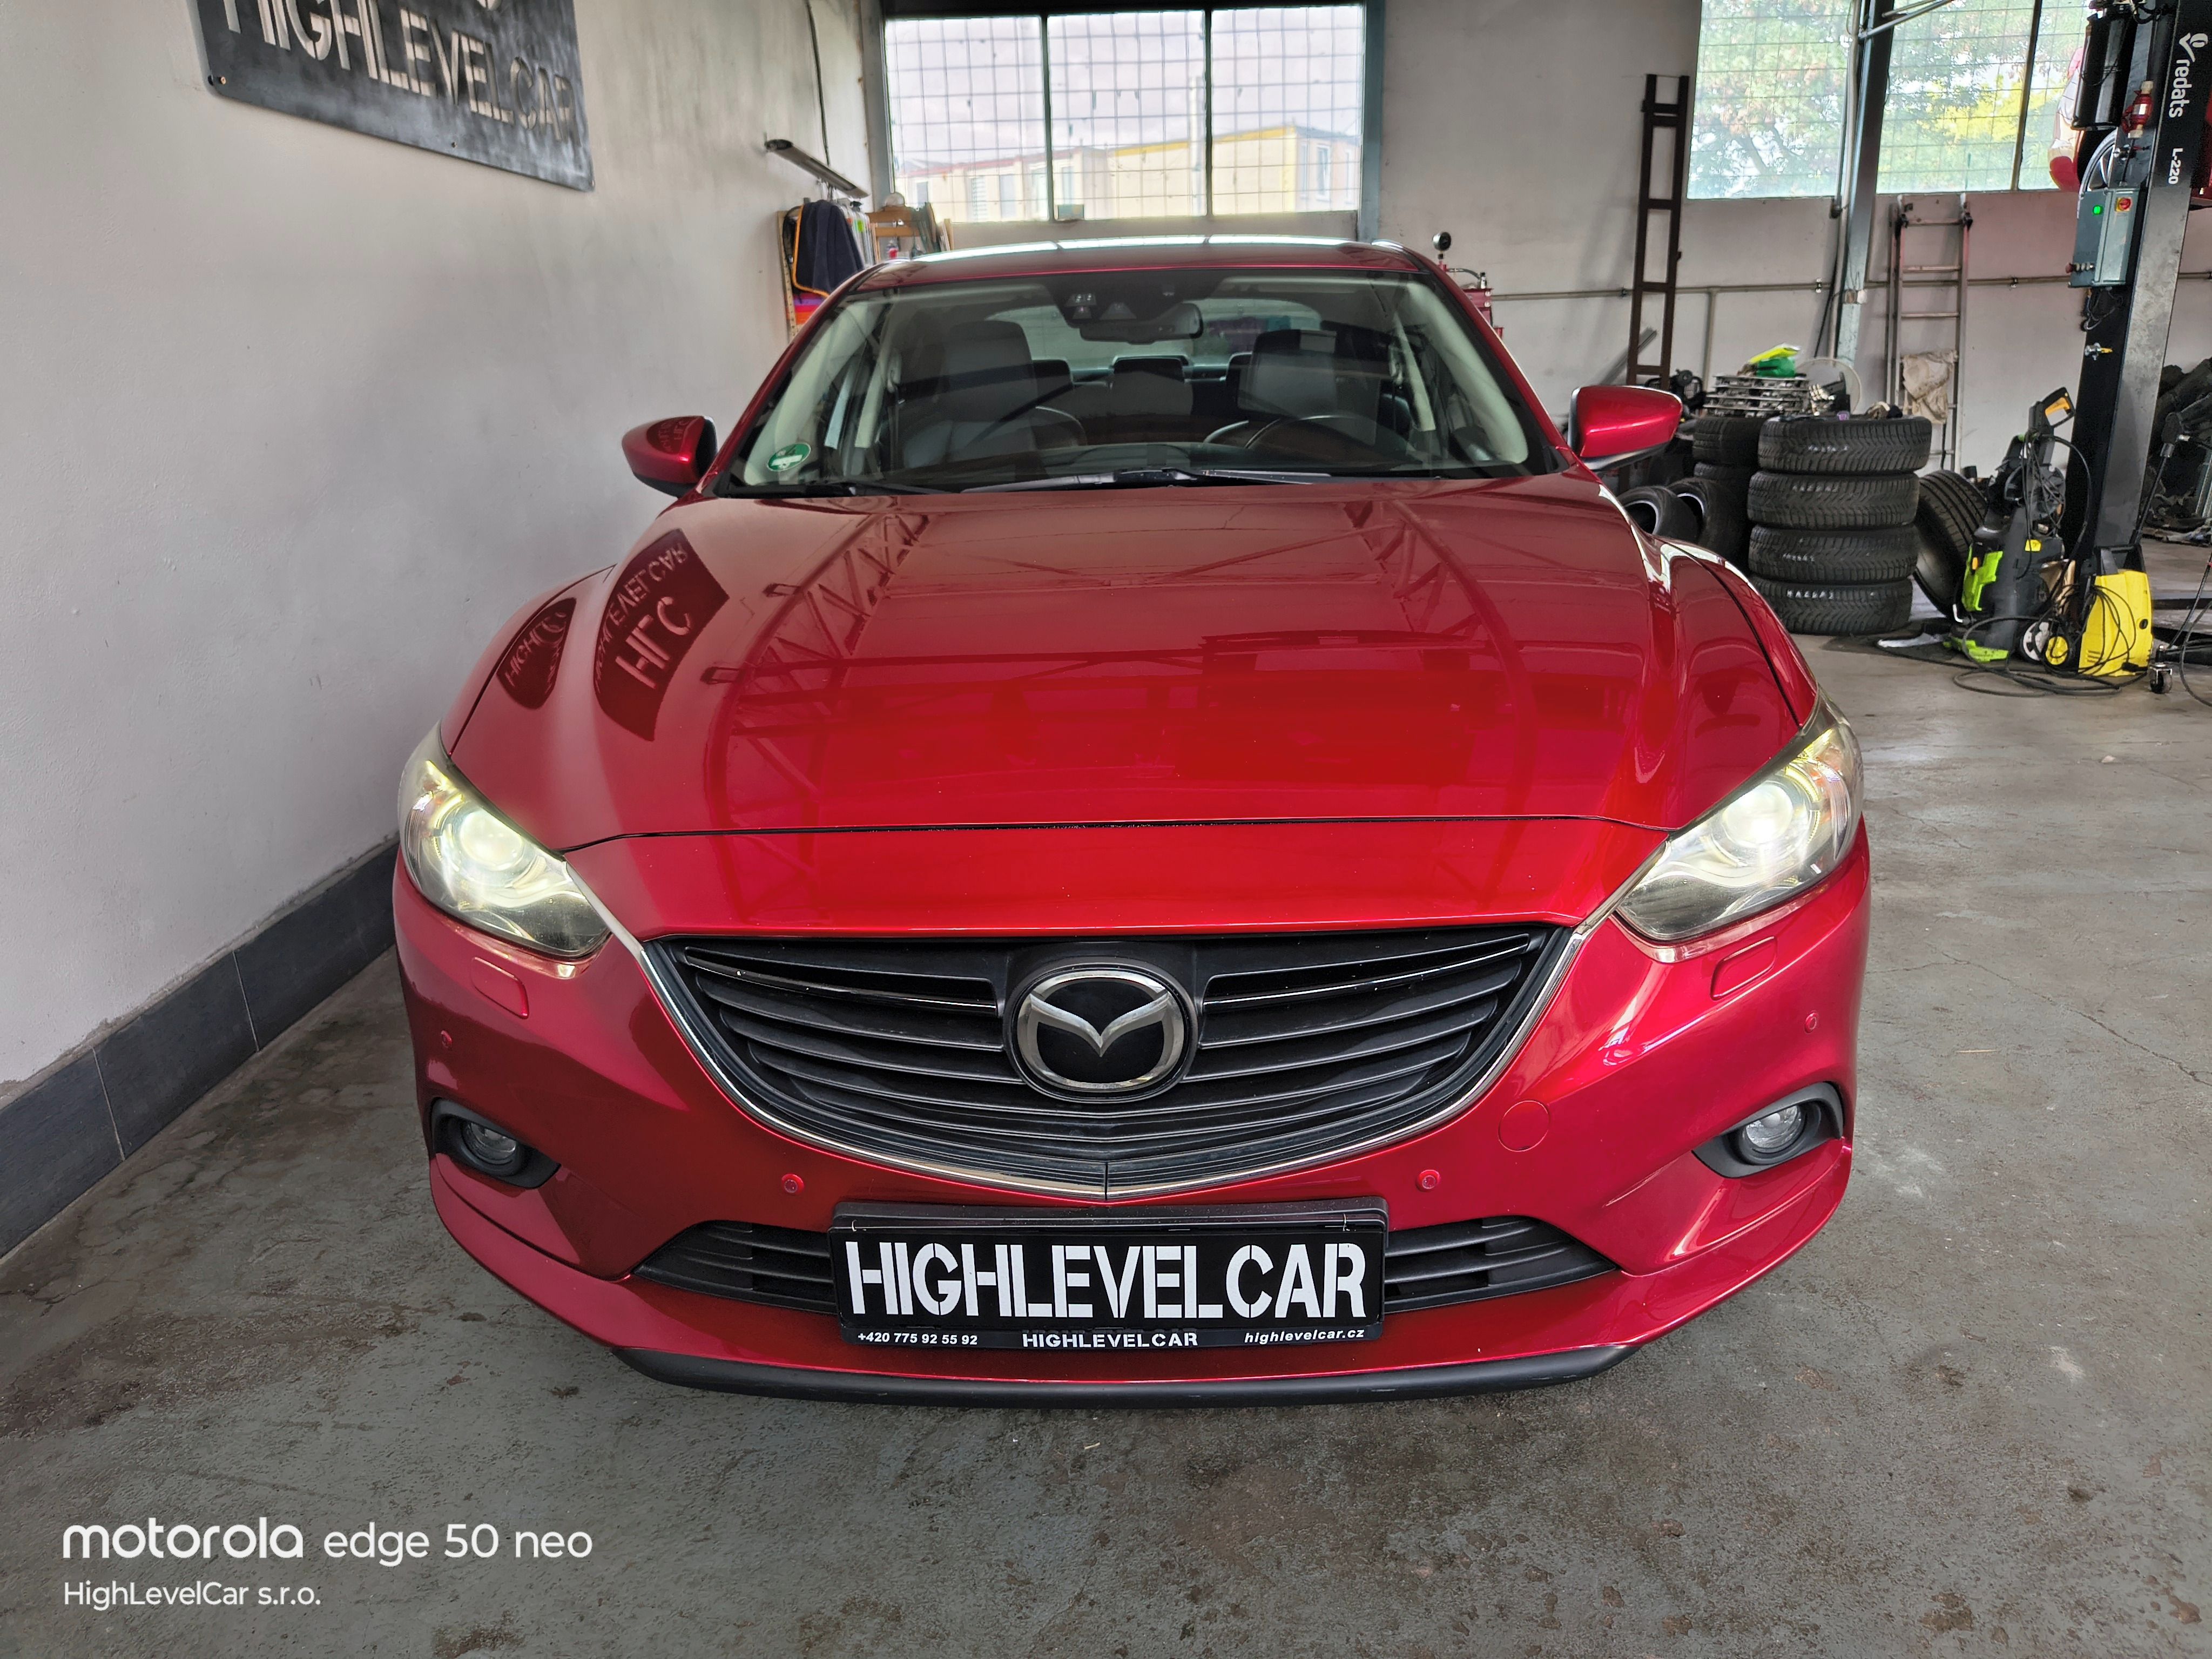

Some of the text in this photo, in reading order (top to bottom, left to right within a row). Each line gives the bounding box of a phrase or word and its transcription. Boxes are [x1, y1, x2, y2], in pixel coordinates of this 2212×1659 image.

[2169, 59, 2192, 118] redats
[2169, 148, 2183, 185] L-220
[858, 1332, 977, 1345] +420 775 92 55 92
[1244, 1329, 1365, 1345] highlevelcar.cz
